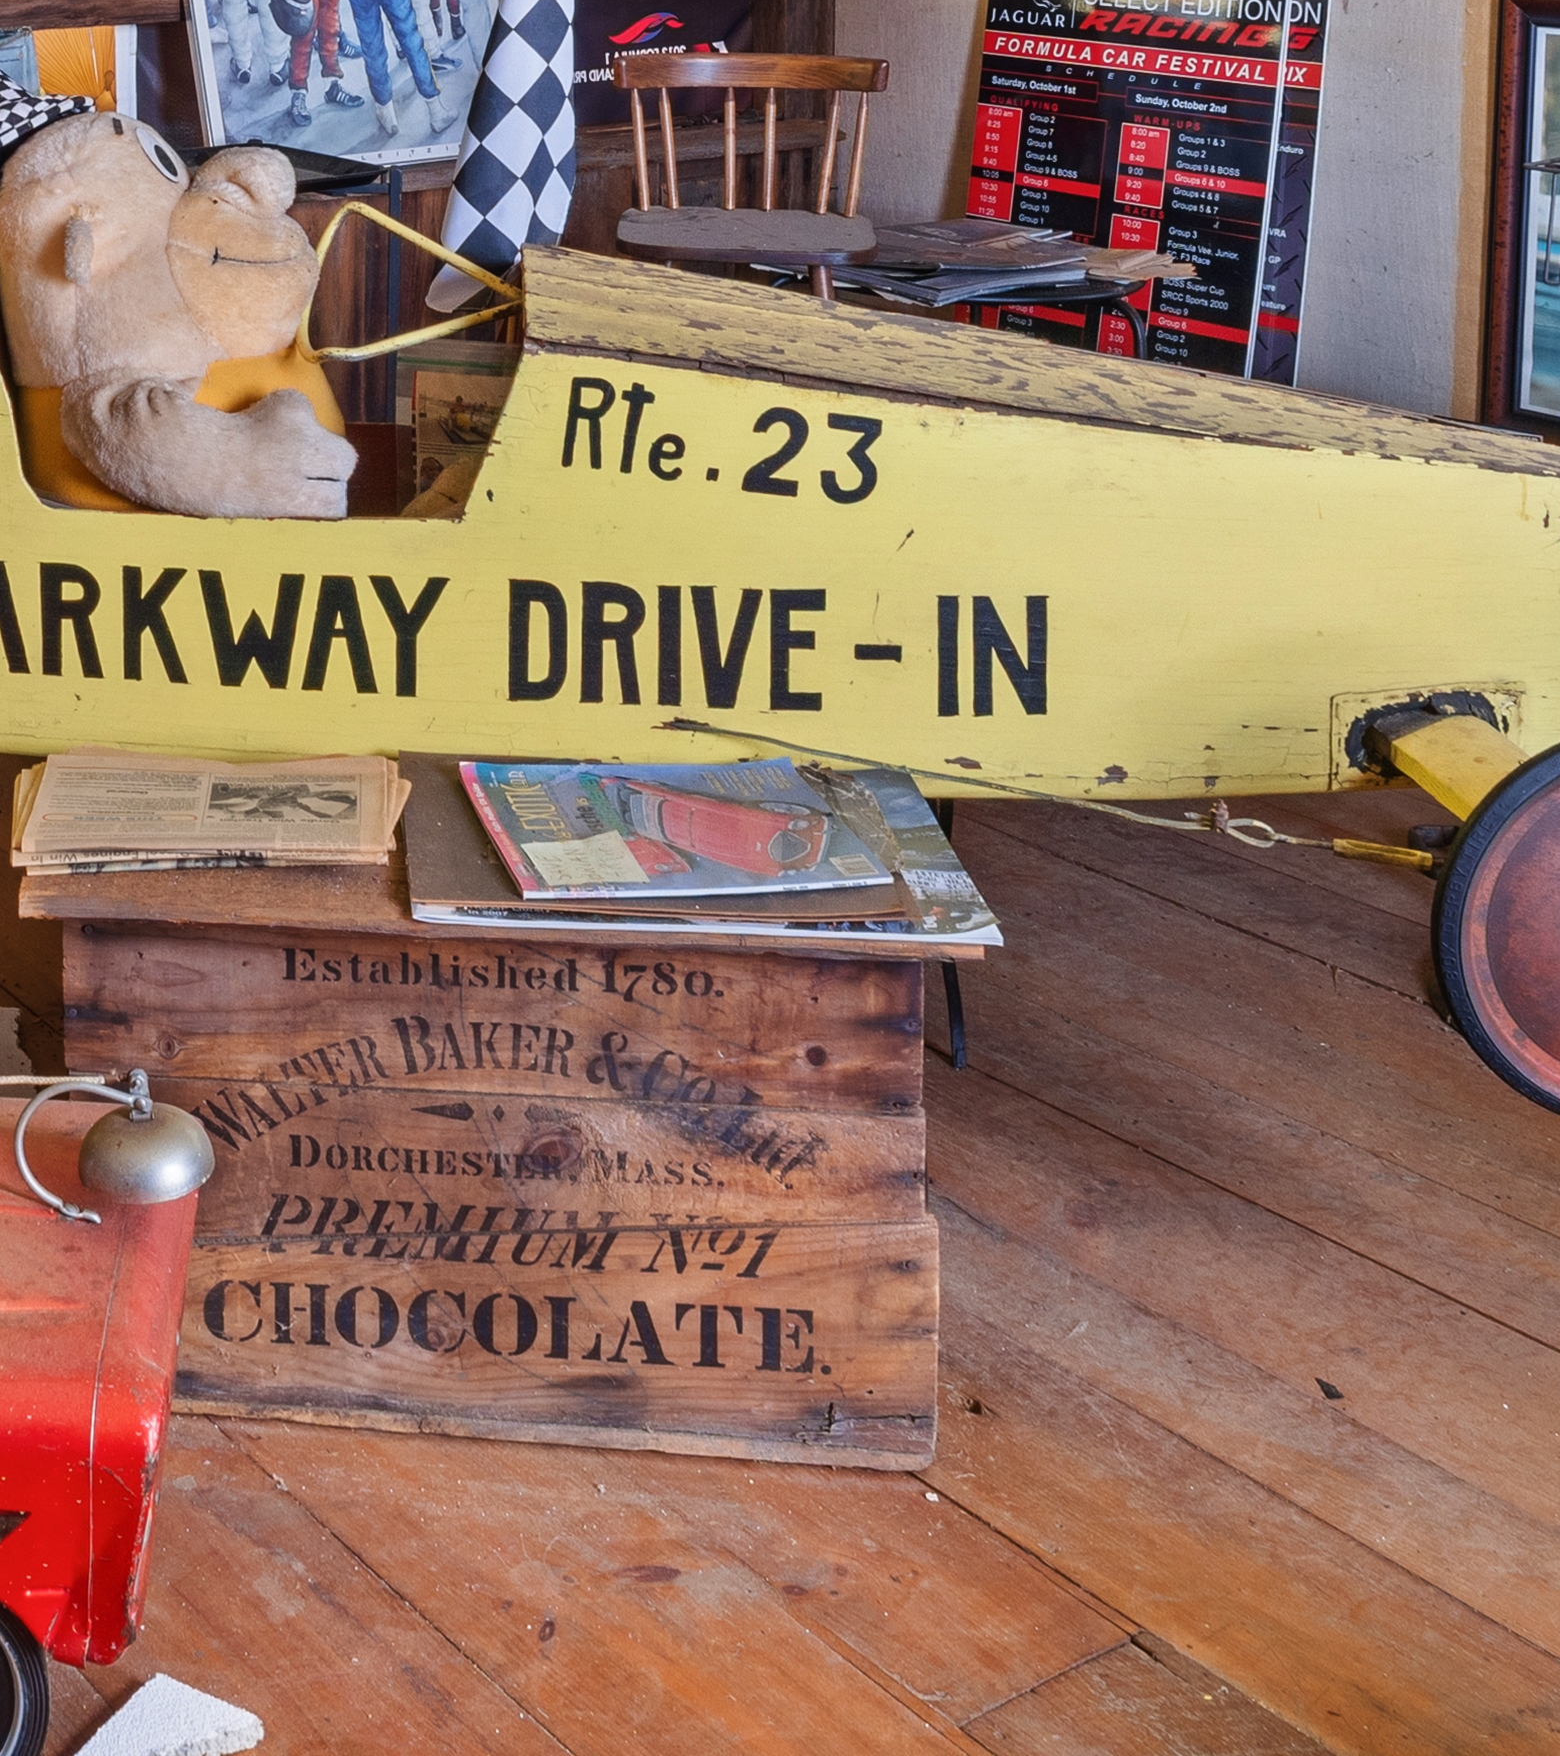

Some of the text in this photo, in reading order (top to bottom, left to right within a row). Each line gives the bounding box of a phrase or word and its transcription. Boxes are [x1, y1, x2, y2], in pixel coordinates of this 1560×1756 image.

[990, 7, 1066, 28] JAGUAR
[1078, 8, 1281, 48] RACING
[994, 35, 1092, 61] FORMULA
[1102, 48, 1147, 67] CAR
[1155, 54, 1266, 81] FESTIVAL
[991, 75, 1077, 95] Saturday, October 1st
[1045, 64, 1202, 91] SCHEDULE
[989, 94, 1060, 112] QUALIFYING
[1135, 93, 1228, 114] Sunday, October 2nd
[1029, 112, 1050, 124] Group
[1133, 114, 1201, 132] WARM-UPS
[1028, 125, 1048, 136] Group
[1026, 137, 1047, 149] Group
[1025, 150, 1046, 162] Group
[1177, 146, 1200, 158] Group
[1024, 163, 1044, 175] Group
[1022, 175, 1043, 187] Group
[1021, 188, 1042, 200] Group
[1019, 201, 1041, 212] Group
[1123, 205, 1166, 220] RACES
[1018, 213, 1039, 225] Group
[1209, 283, 1225, 296] Cup
[561, 376, 883, 505] Rte. 23
[30, 854, 44, 863] In
[49, 852, 78, 863] Win
[281, 947, 726, 1003] Established 1780.
[192, 1014, 632, 1151] WALTER BAKER &
[260, 1192, 621, 1276] PREMIUM
[202, 1278, 834, 1377] CHOCOLATE.
